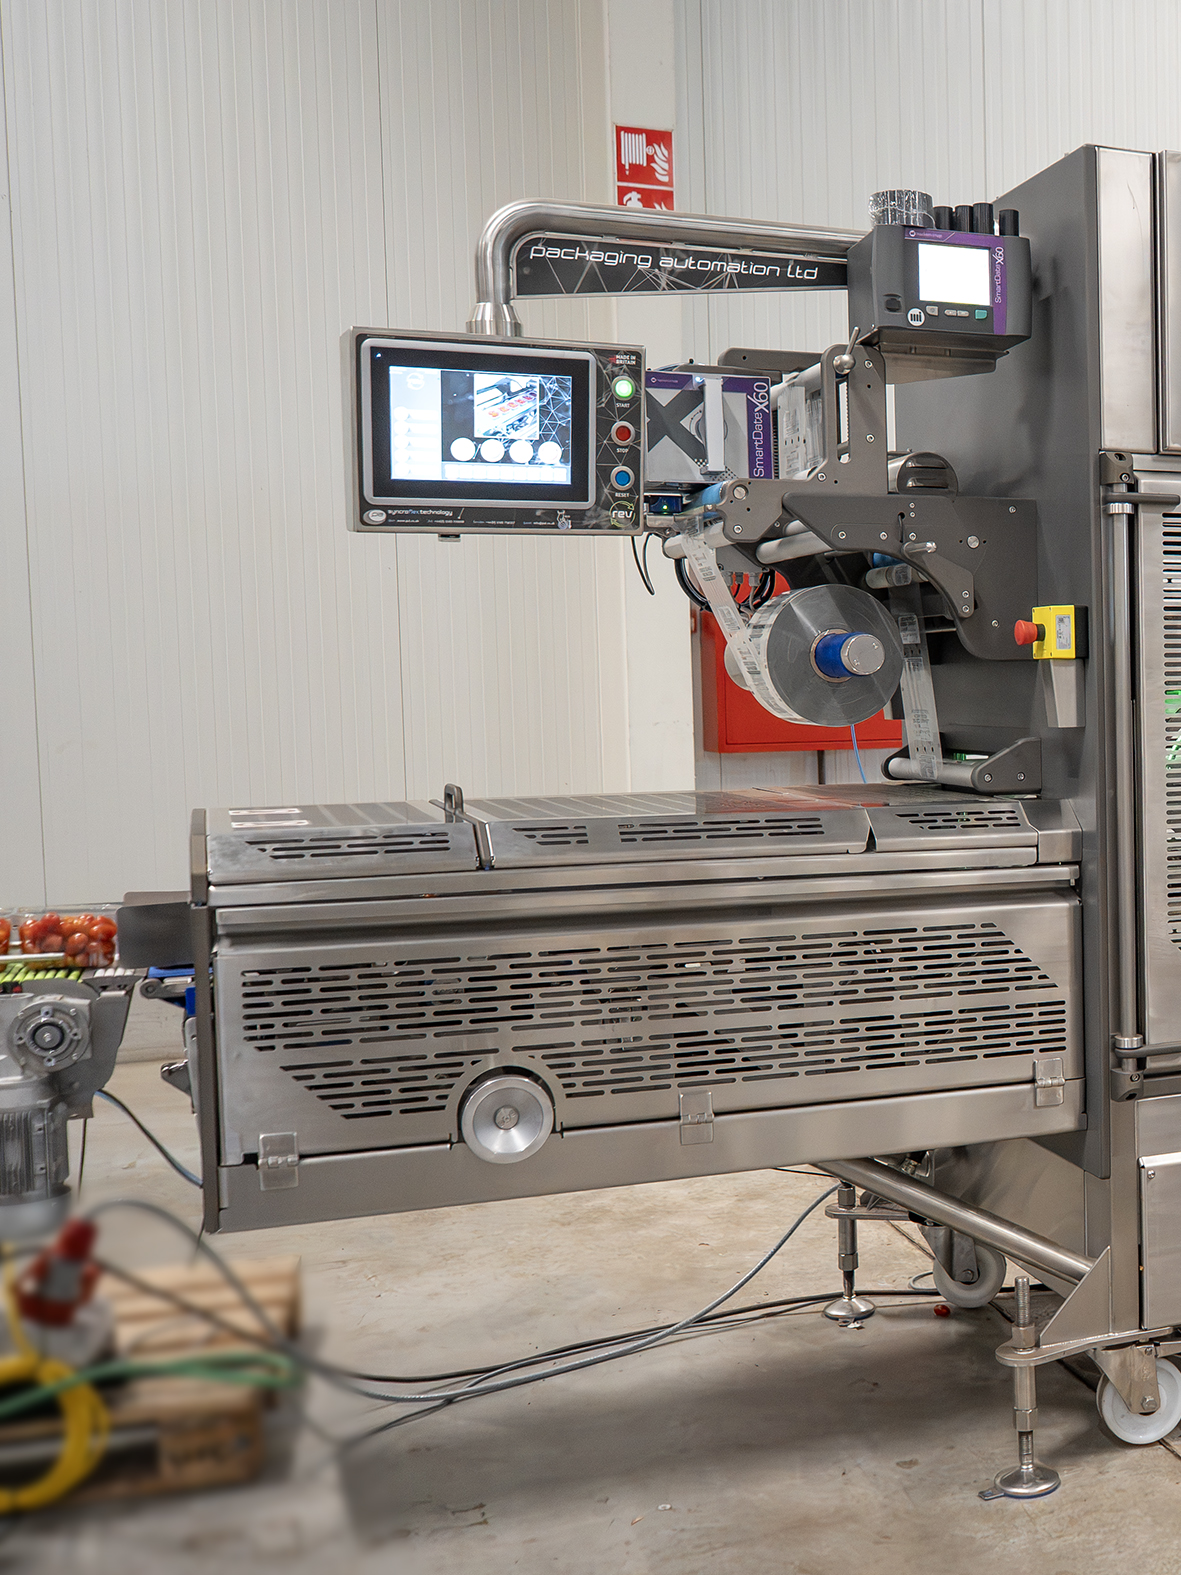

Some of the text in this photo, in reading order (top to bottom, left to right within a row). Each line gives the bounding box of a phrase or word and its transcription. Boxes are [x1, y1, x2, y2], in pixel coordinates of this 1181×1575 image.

[529, 245, 653, 268] packaging
[659, 255, 781, 277] automation
[992, 246, 1004, 304] SmartDate X60
[747, 382, 770, 478] SmartDate X60
[419, 509, 454, 517] technology
[612, 509, 633, 519] rev
